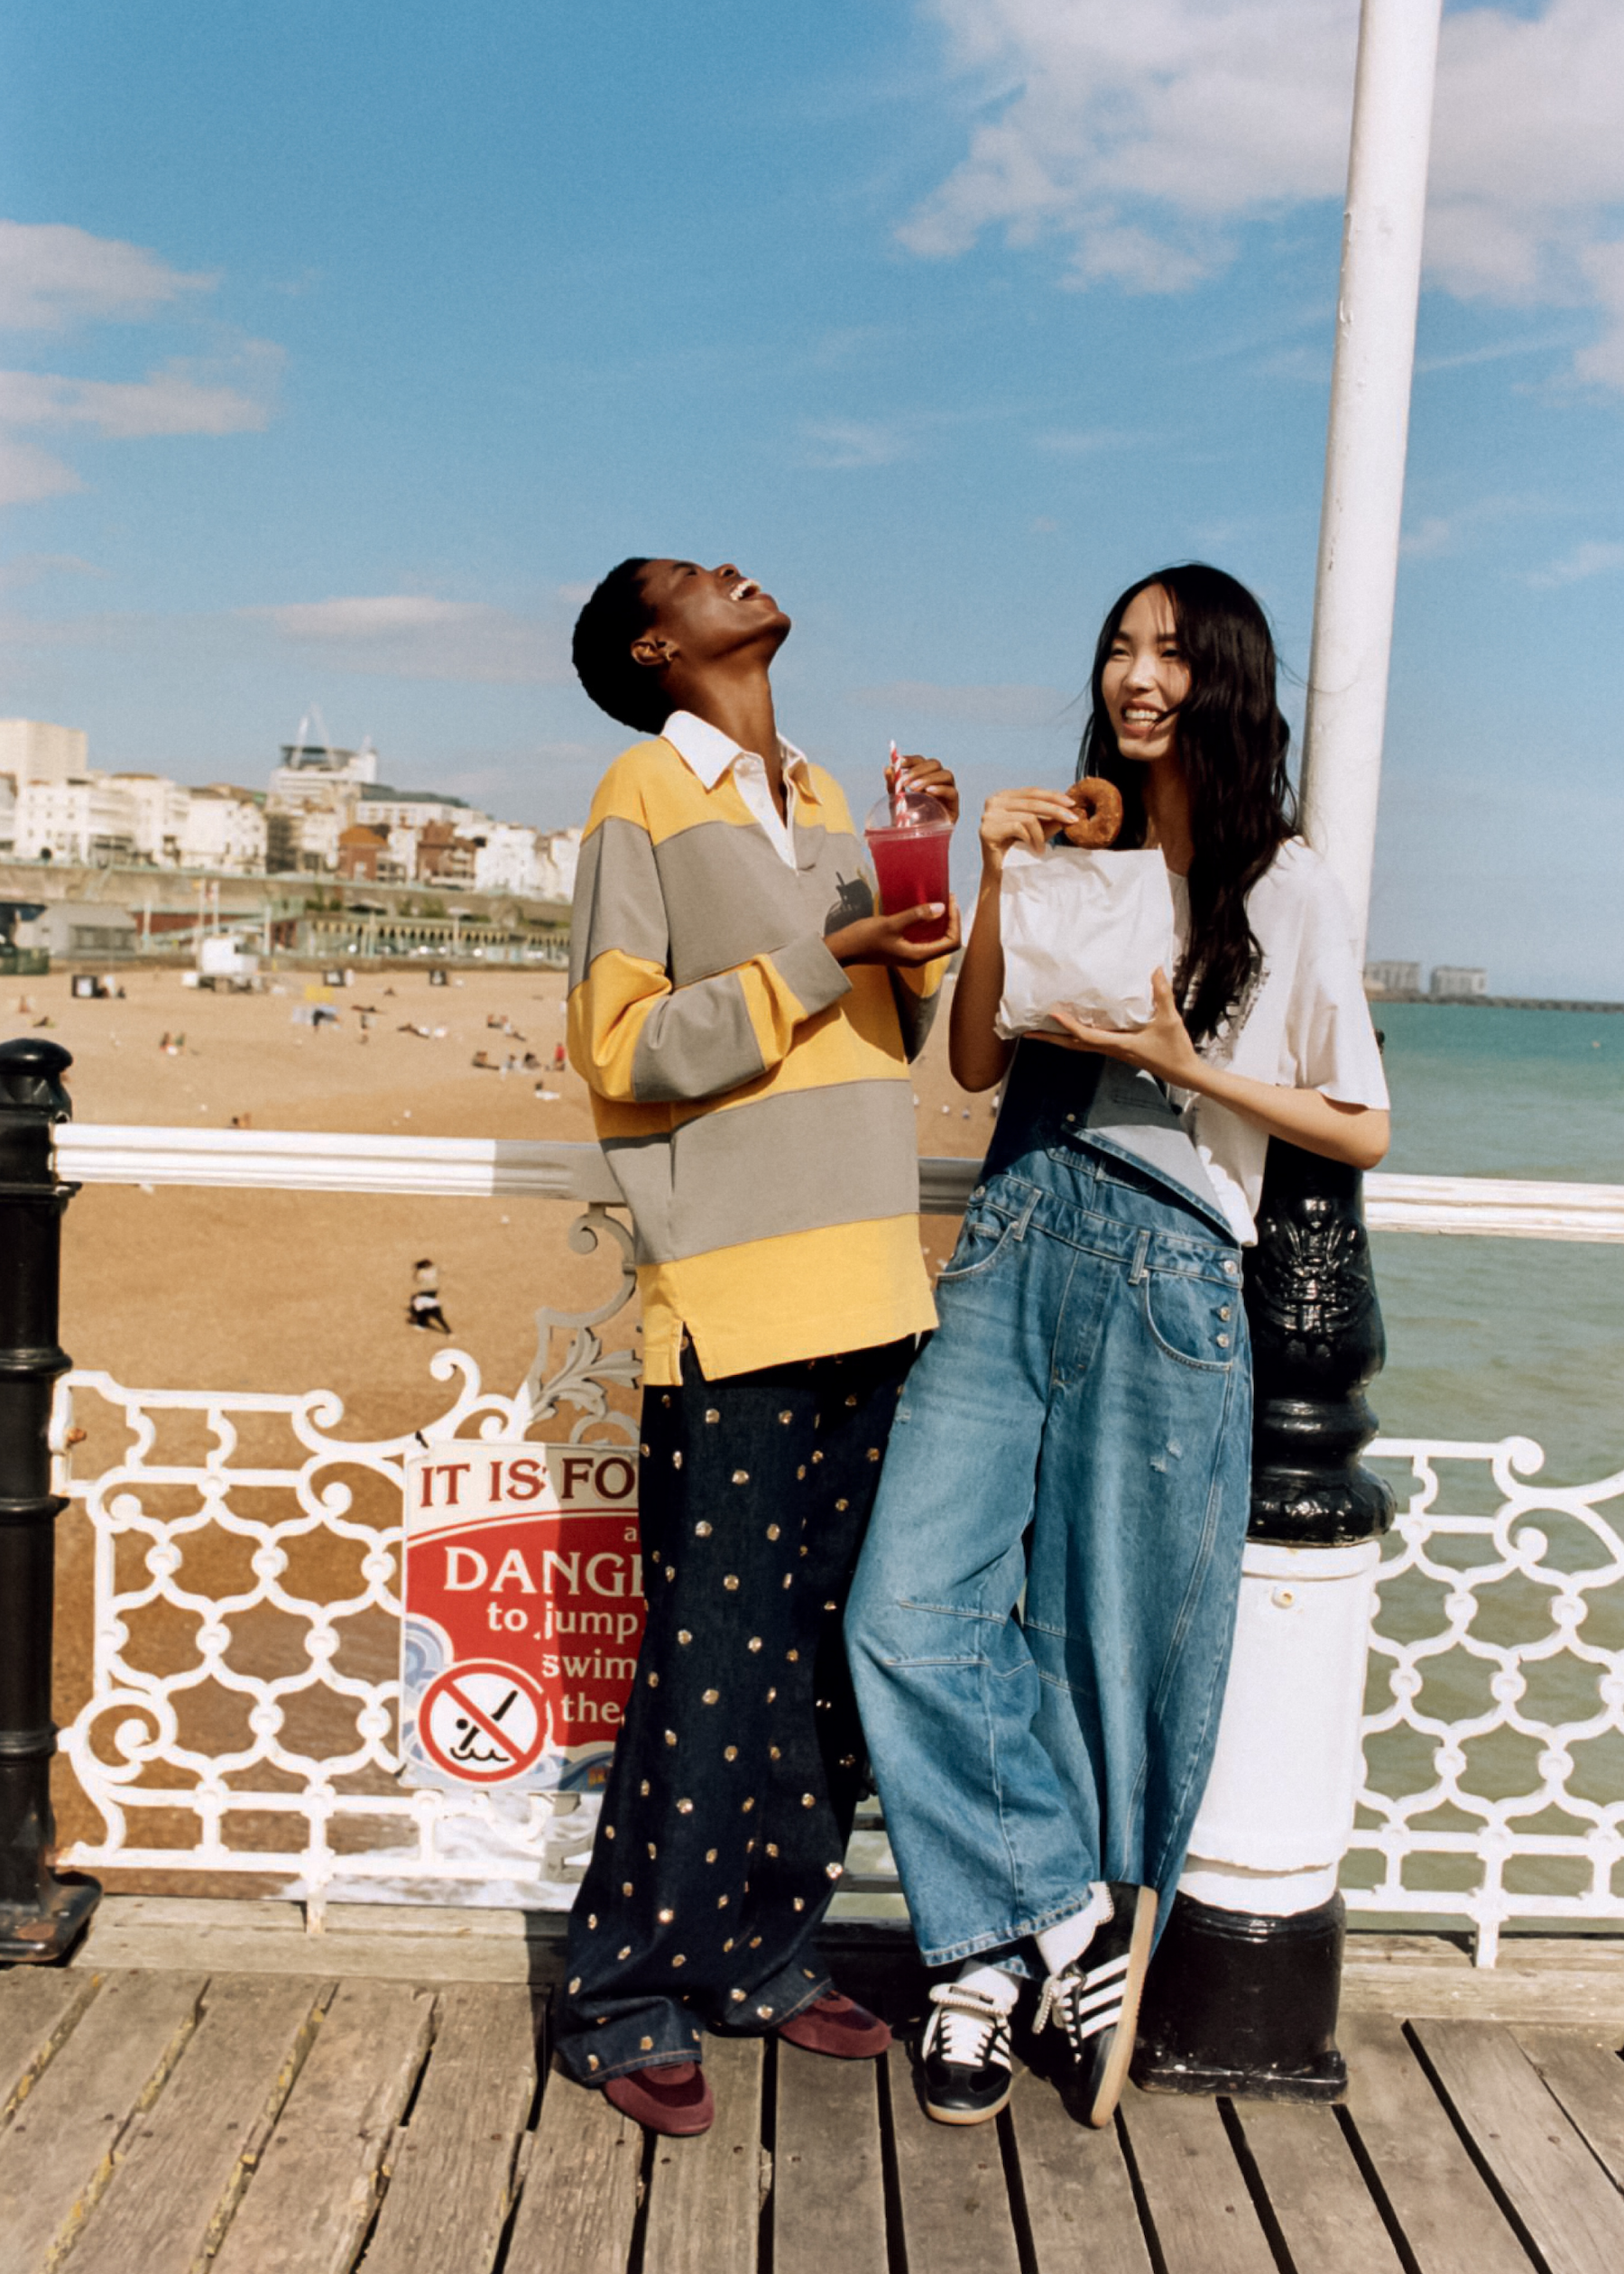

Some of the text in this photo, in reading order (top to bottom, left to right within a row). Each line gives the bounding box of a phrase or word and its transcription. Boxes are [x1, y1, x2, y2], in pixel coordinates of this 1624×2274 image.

[420, 1463, 471, 1508] IT
[488, 1458, 548, 1502] IS
[487, 1601, 639, 1644] to jump
[541, 1648, 637, 1679] swim
[560, 1692, 621, 1724] the
